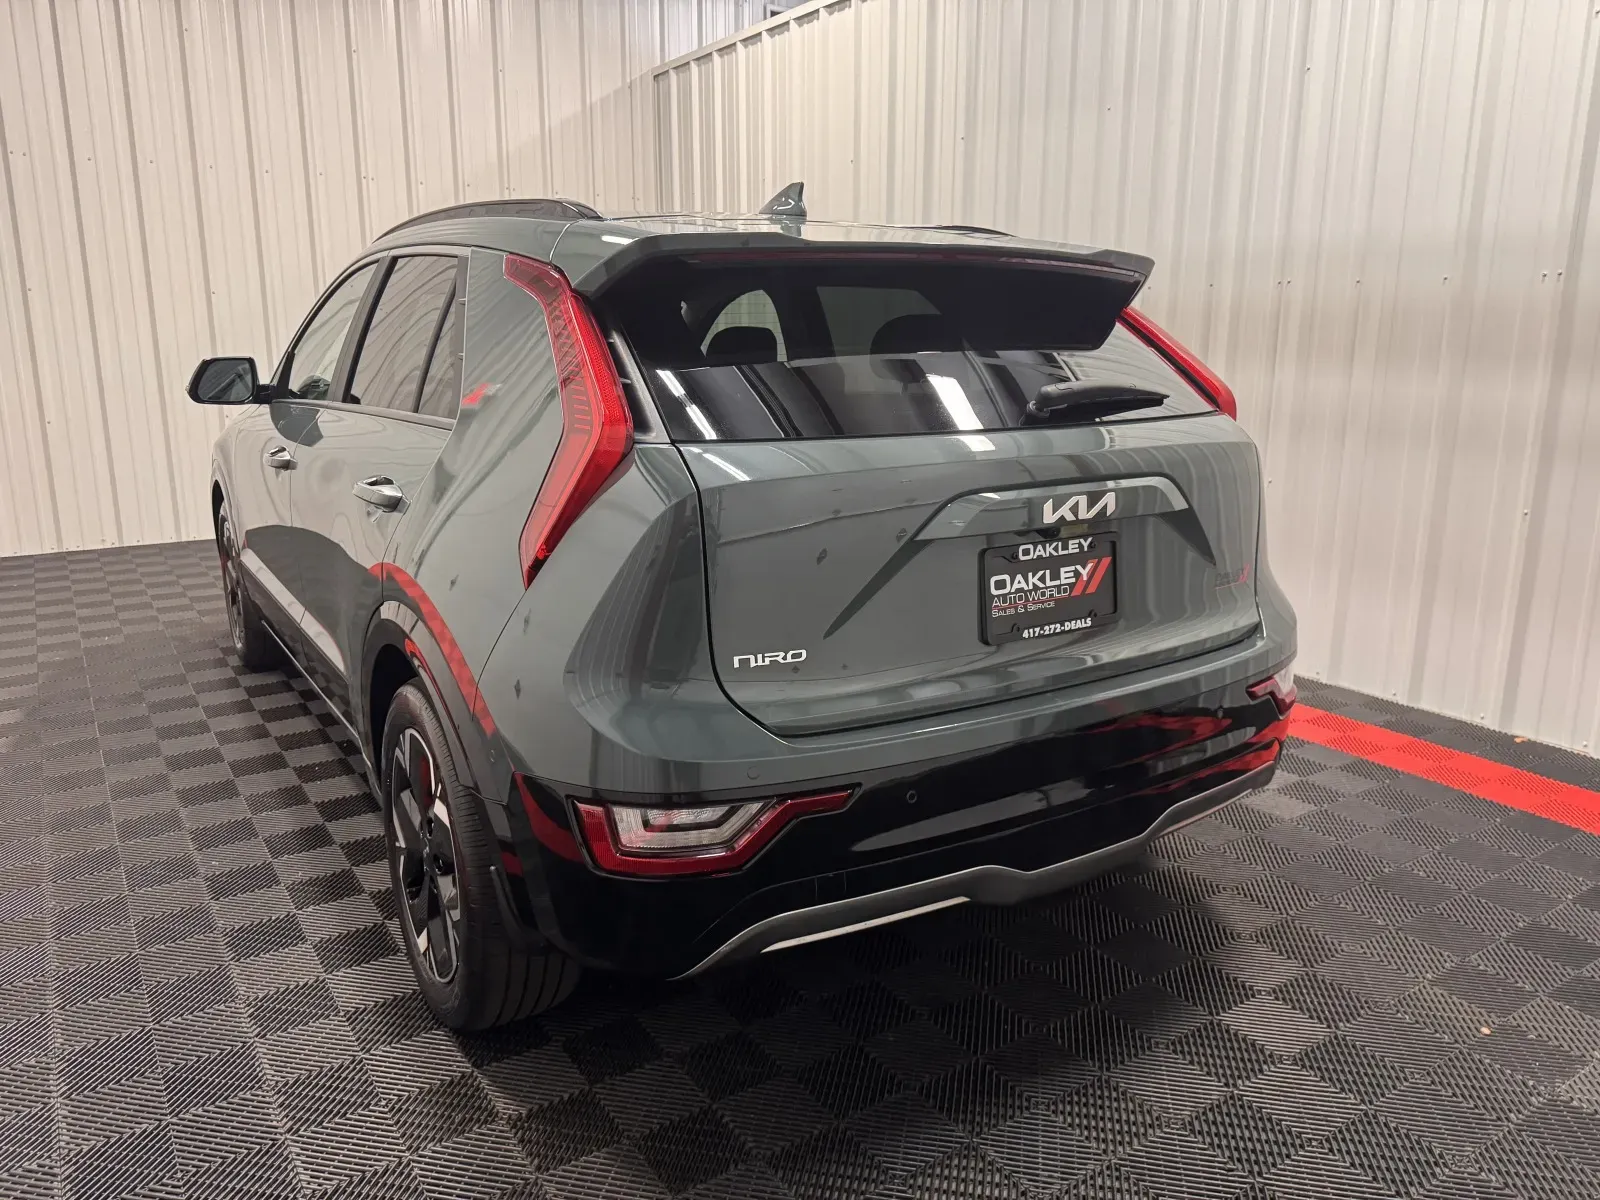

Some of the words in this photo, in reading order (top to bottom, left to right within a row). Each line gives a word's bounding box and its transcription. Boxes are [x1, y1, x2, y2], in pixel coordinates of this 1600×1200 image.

[1042, 491, 1116, 524] KIA
[1018, 536, 1093, 561] OAKLEY
[990, 562, 1094, 596] OAKLEY
[991, 592, 1025, 608] AUTO
[1027, 585, 1070, 601] WORLD
[991, 607, 1016, 618] SALES
[1017, 605, 1025, 613] &
[1027, 601, 1056, 612] SERVICE
[1022, 617, 1092, 639] 417-272-DEALS
[733, 649, 807, 669] NIRO
